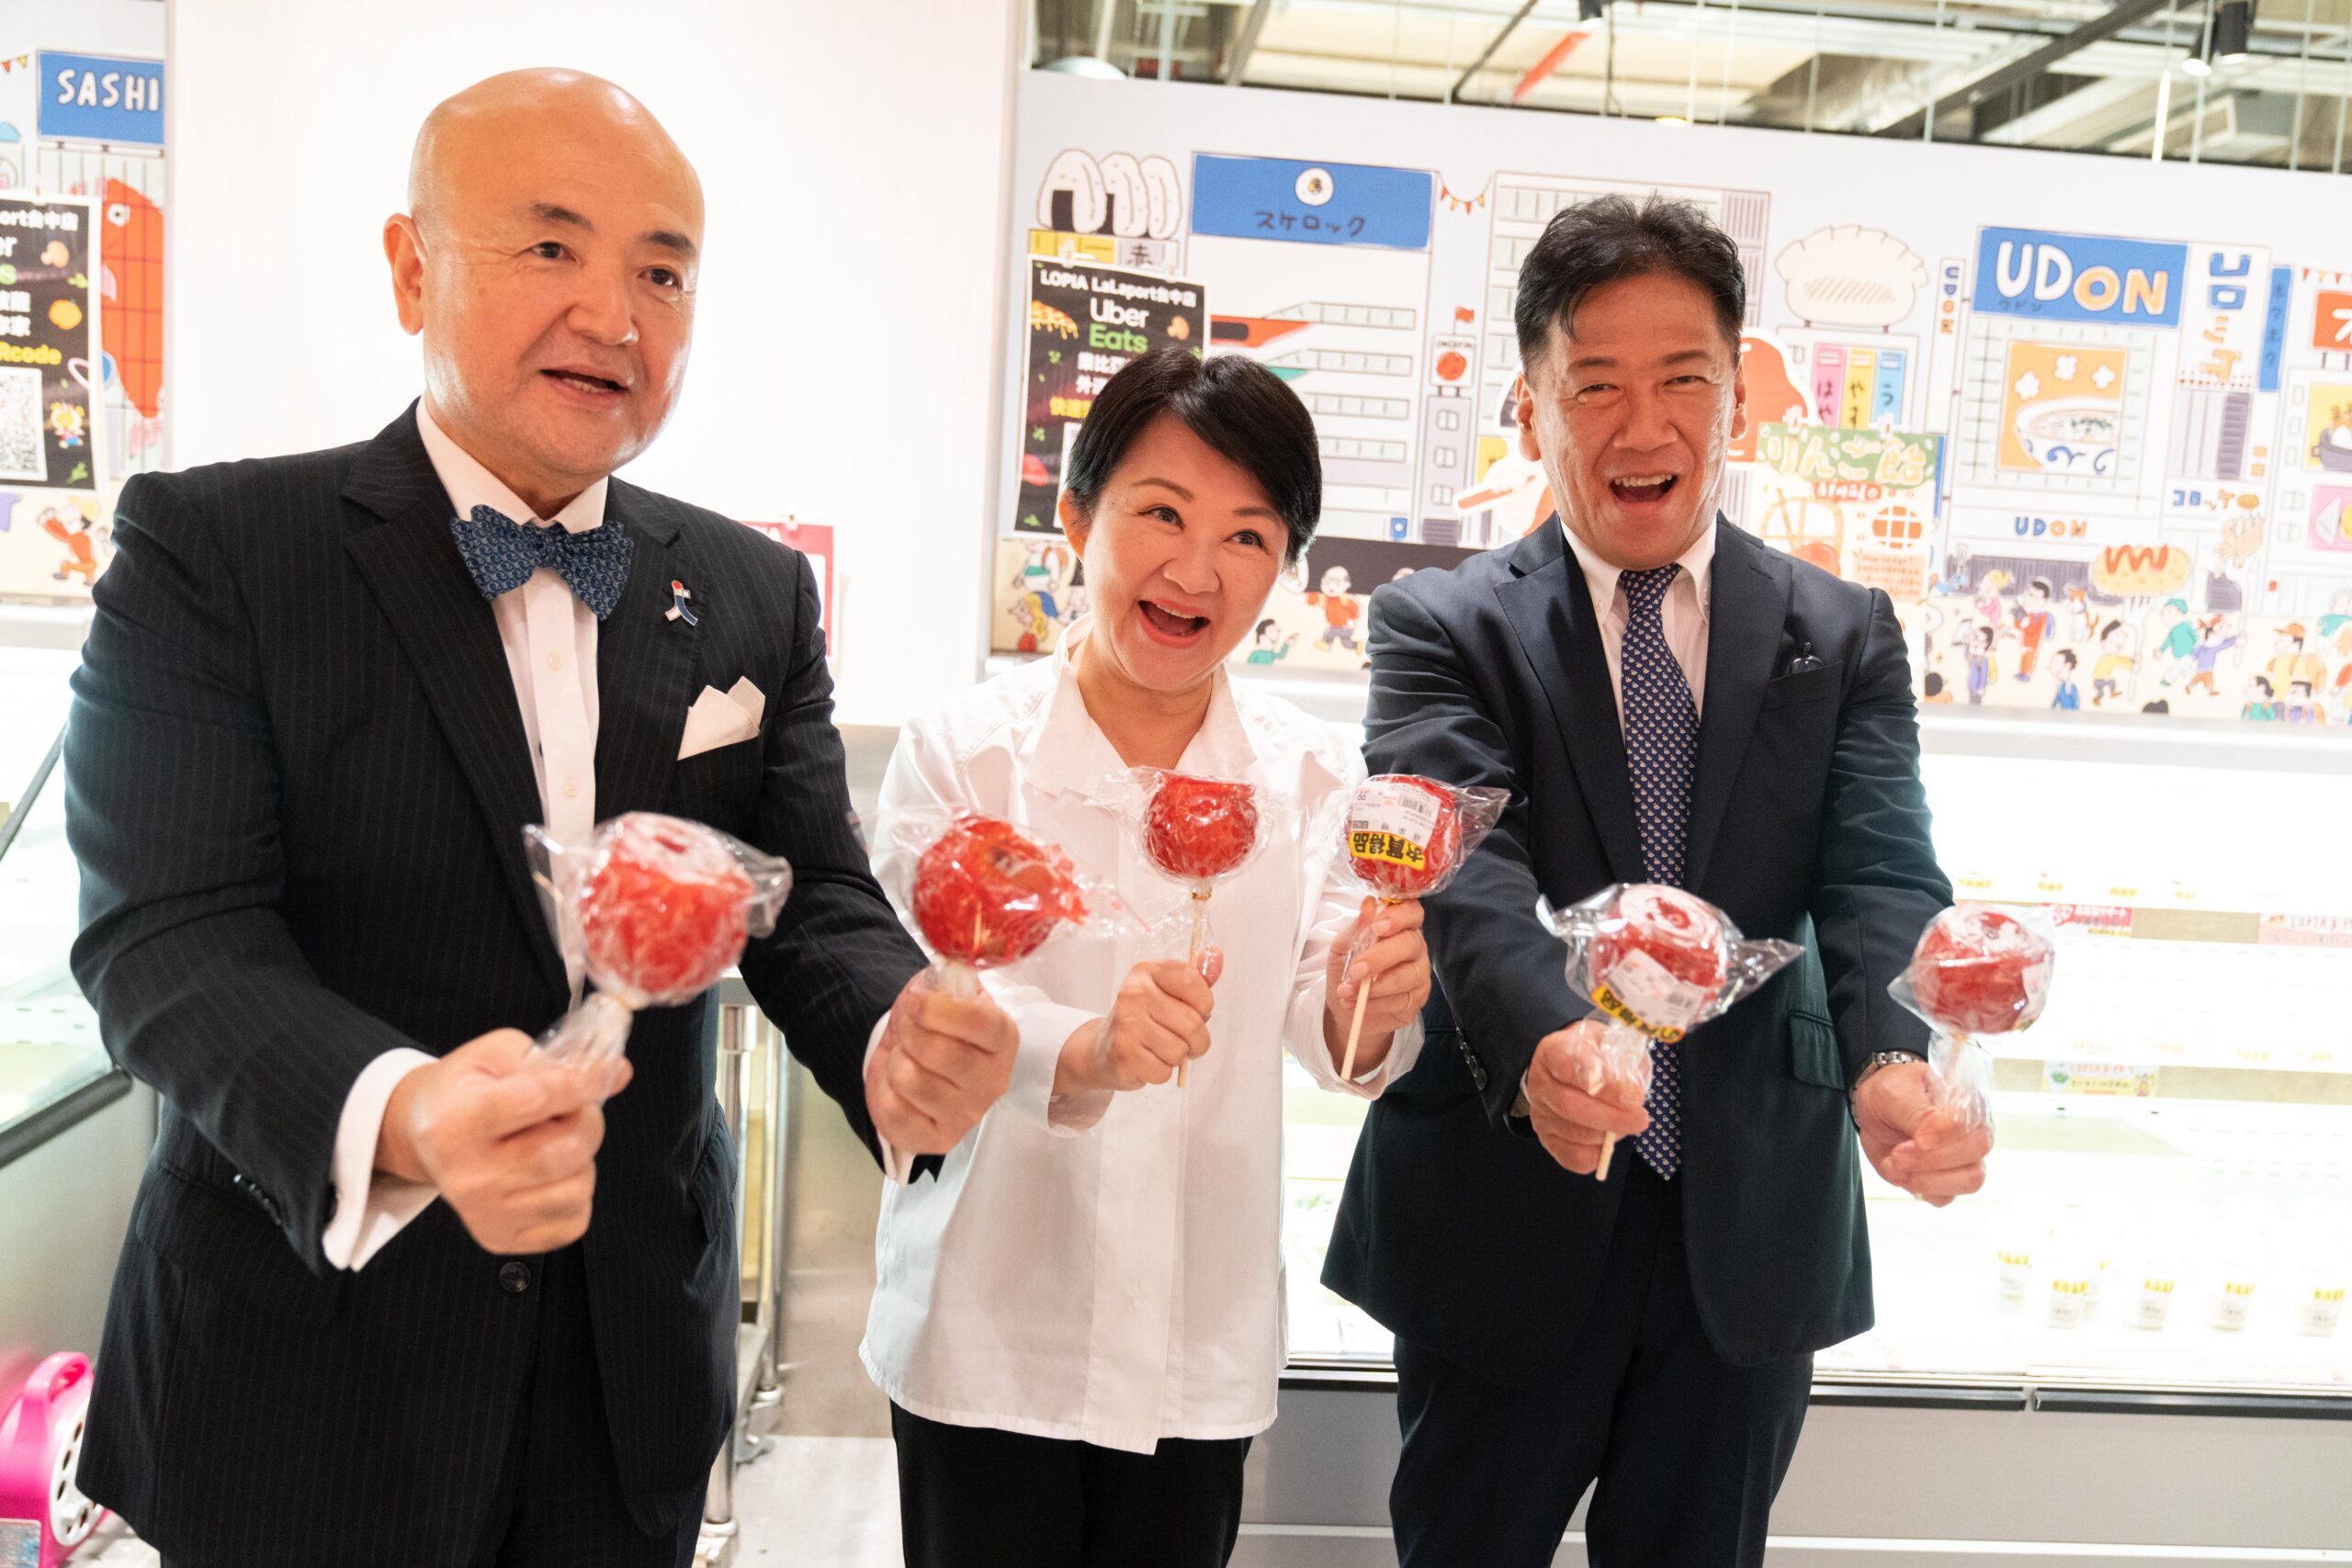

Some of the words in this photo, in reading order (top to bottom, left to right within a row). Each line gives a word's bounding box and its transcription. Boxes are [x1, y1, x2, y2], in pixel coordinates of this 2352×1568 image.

[57, 68, 160, 112] SASHI
[1040, 268, 1089, 291] LOPIA
[1996, 240, 2169, 316] UDON
[1090, 297, 1149, 329] Uber
[1089, 323, 1148, 354] Eats
[2015, 515, 2088, 538] UDON
